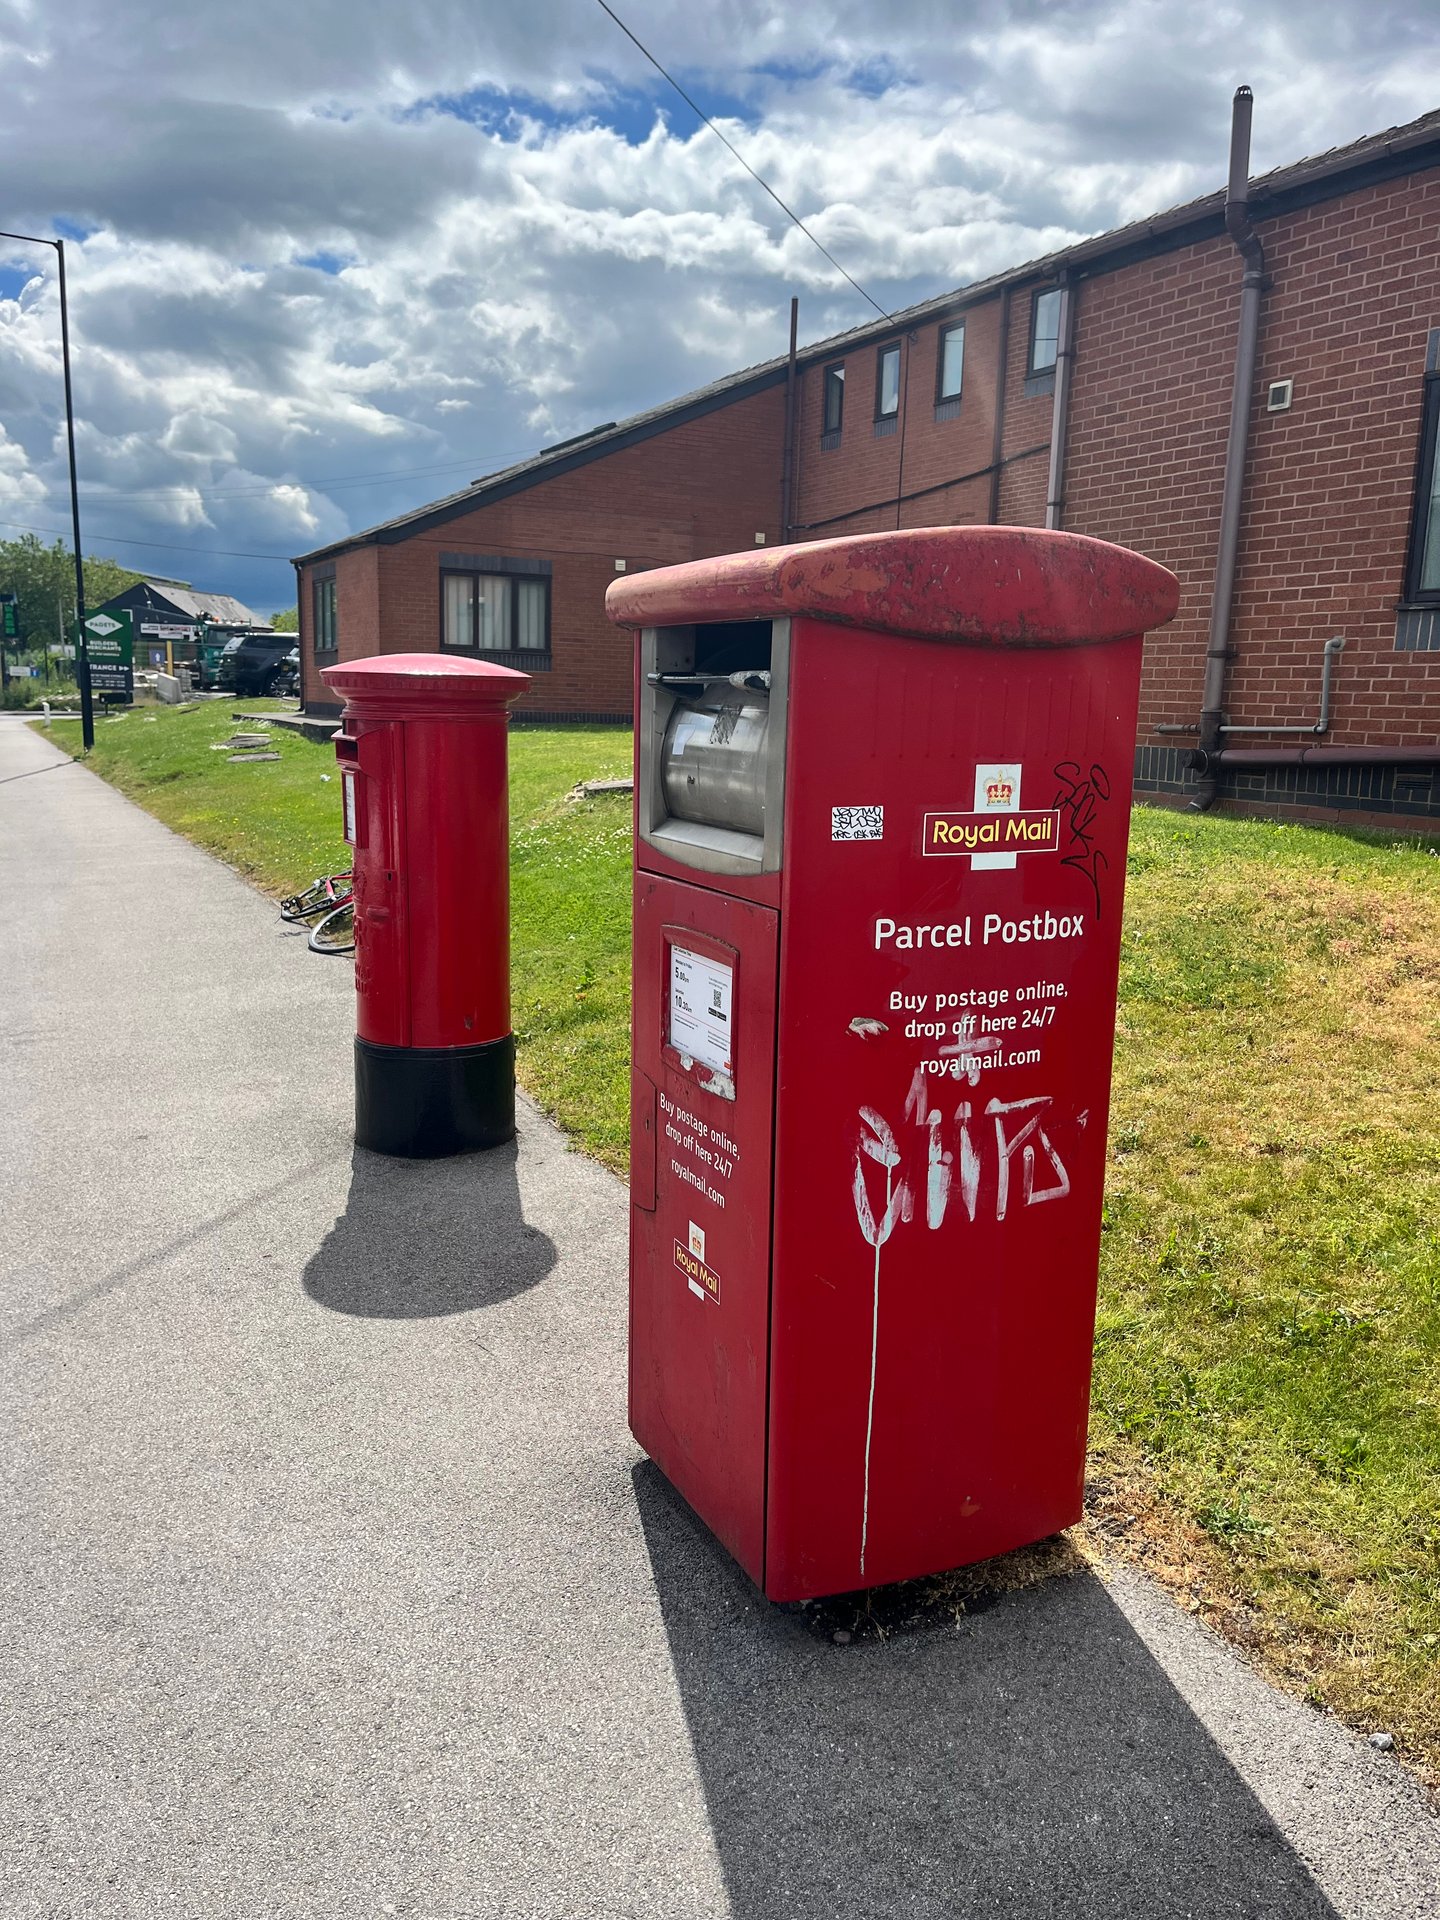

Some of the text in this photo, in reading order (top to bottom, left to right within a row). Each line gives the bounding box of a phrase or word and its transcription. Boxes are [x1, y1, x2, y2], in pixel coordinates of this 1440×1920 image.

[89, 664, 117, 672] TRANCE
[932, 817, 1052, 848] Royal Mail
[875, 911, 1084, 949] Parcel Postbox
[890, 980, 1068, 1013] Buy postage online,
[905, 1006, 1056, 1040] drop off here 24/7
[920, 1049, 1041, 1077] royalmail.com
[660, 1093, 741, 1160] Buy postage online,
[665, 1122, 733, 1179] drop off here 24/7
[671, 1159, 725, 1209] royalmail.com
[676, 1245, 718, 1294] Royal Mail
